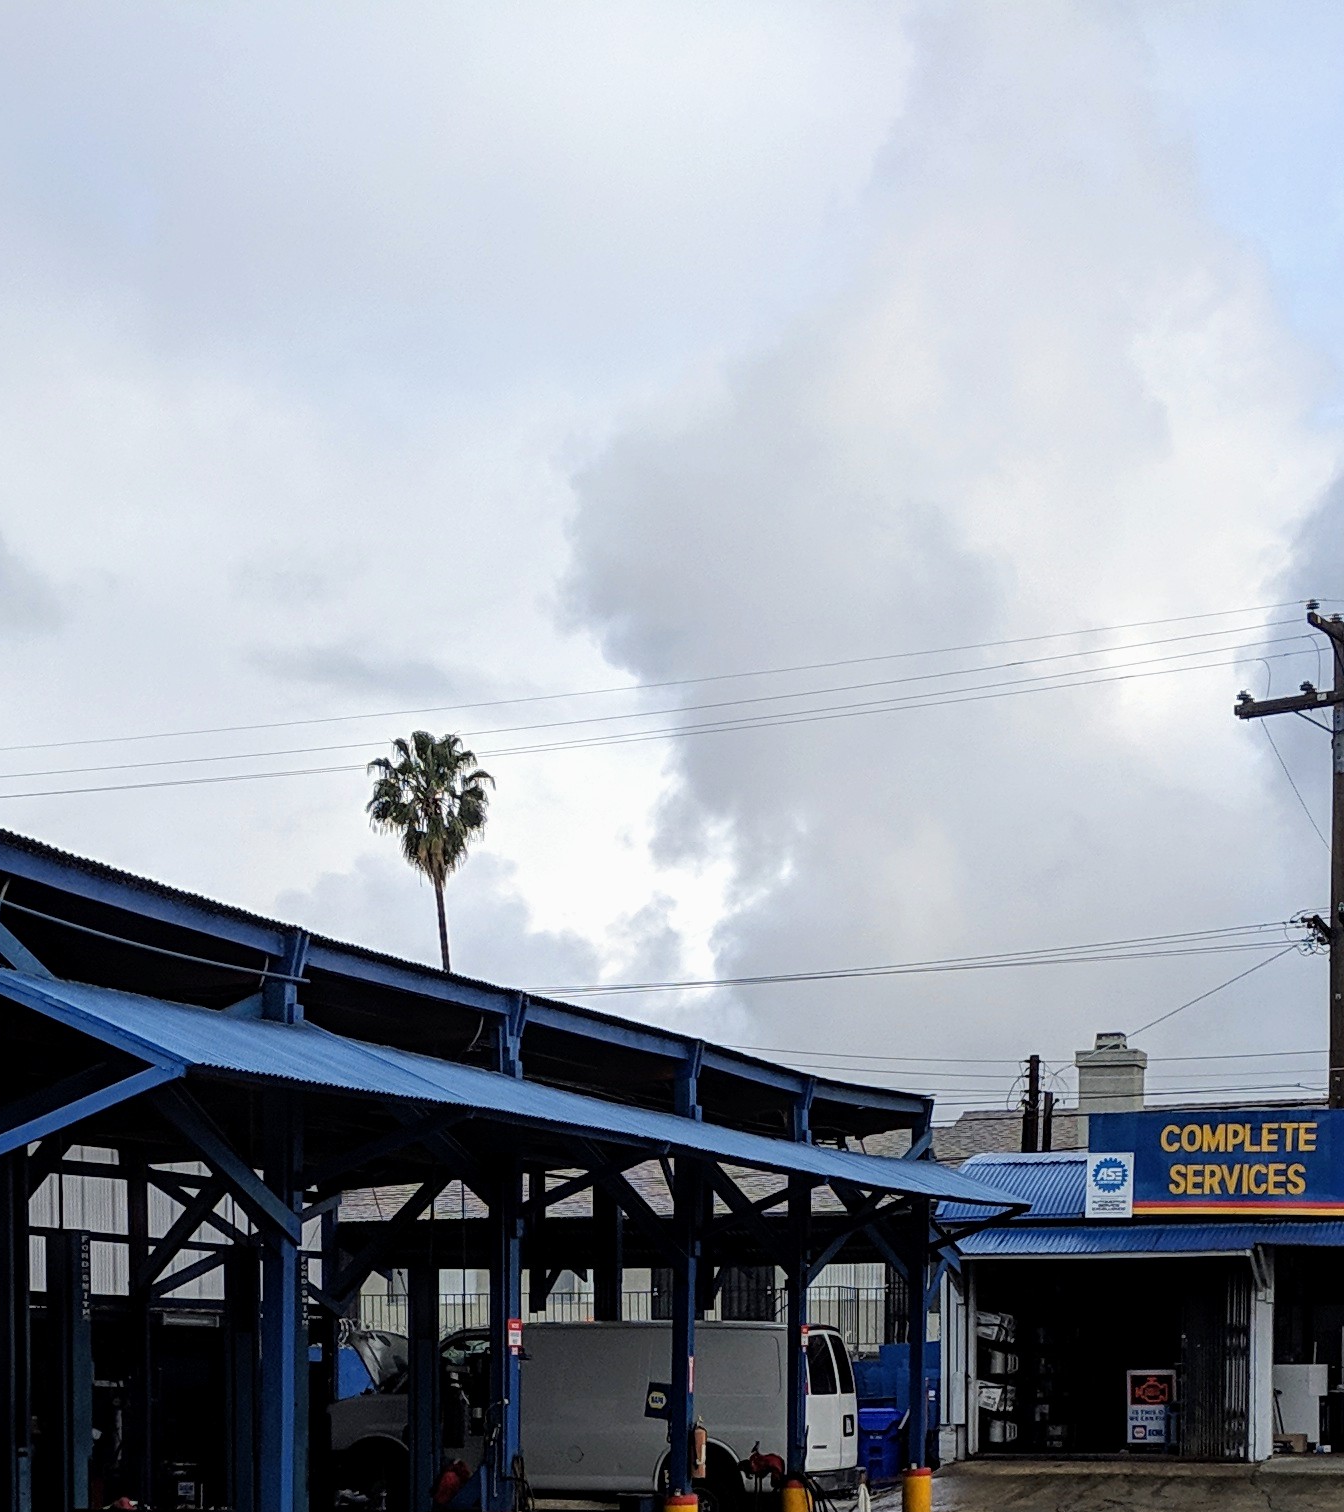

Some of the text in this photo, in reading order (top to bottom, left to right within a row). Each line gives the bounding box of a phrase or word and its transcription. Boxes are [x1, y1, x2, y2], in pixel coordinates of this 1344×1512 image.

[1159, 1121, 1318, 1153] COMPLETE
[1096, 1167, 1123, 1181] ASE
[1168, 1162, 1307, 1196] SERVICES
